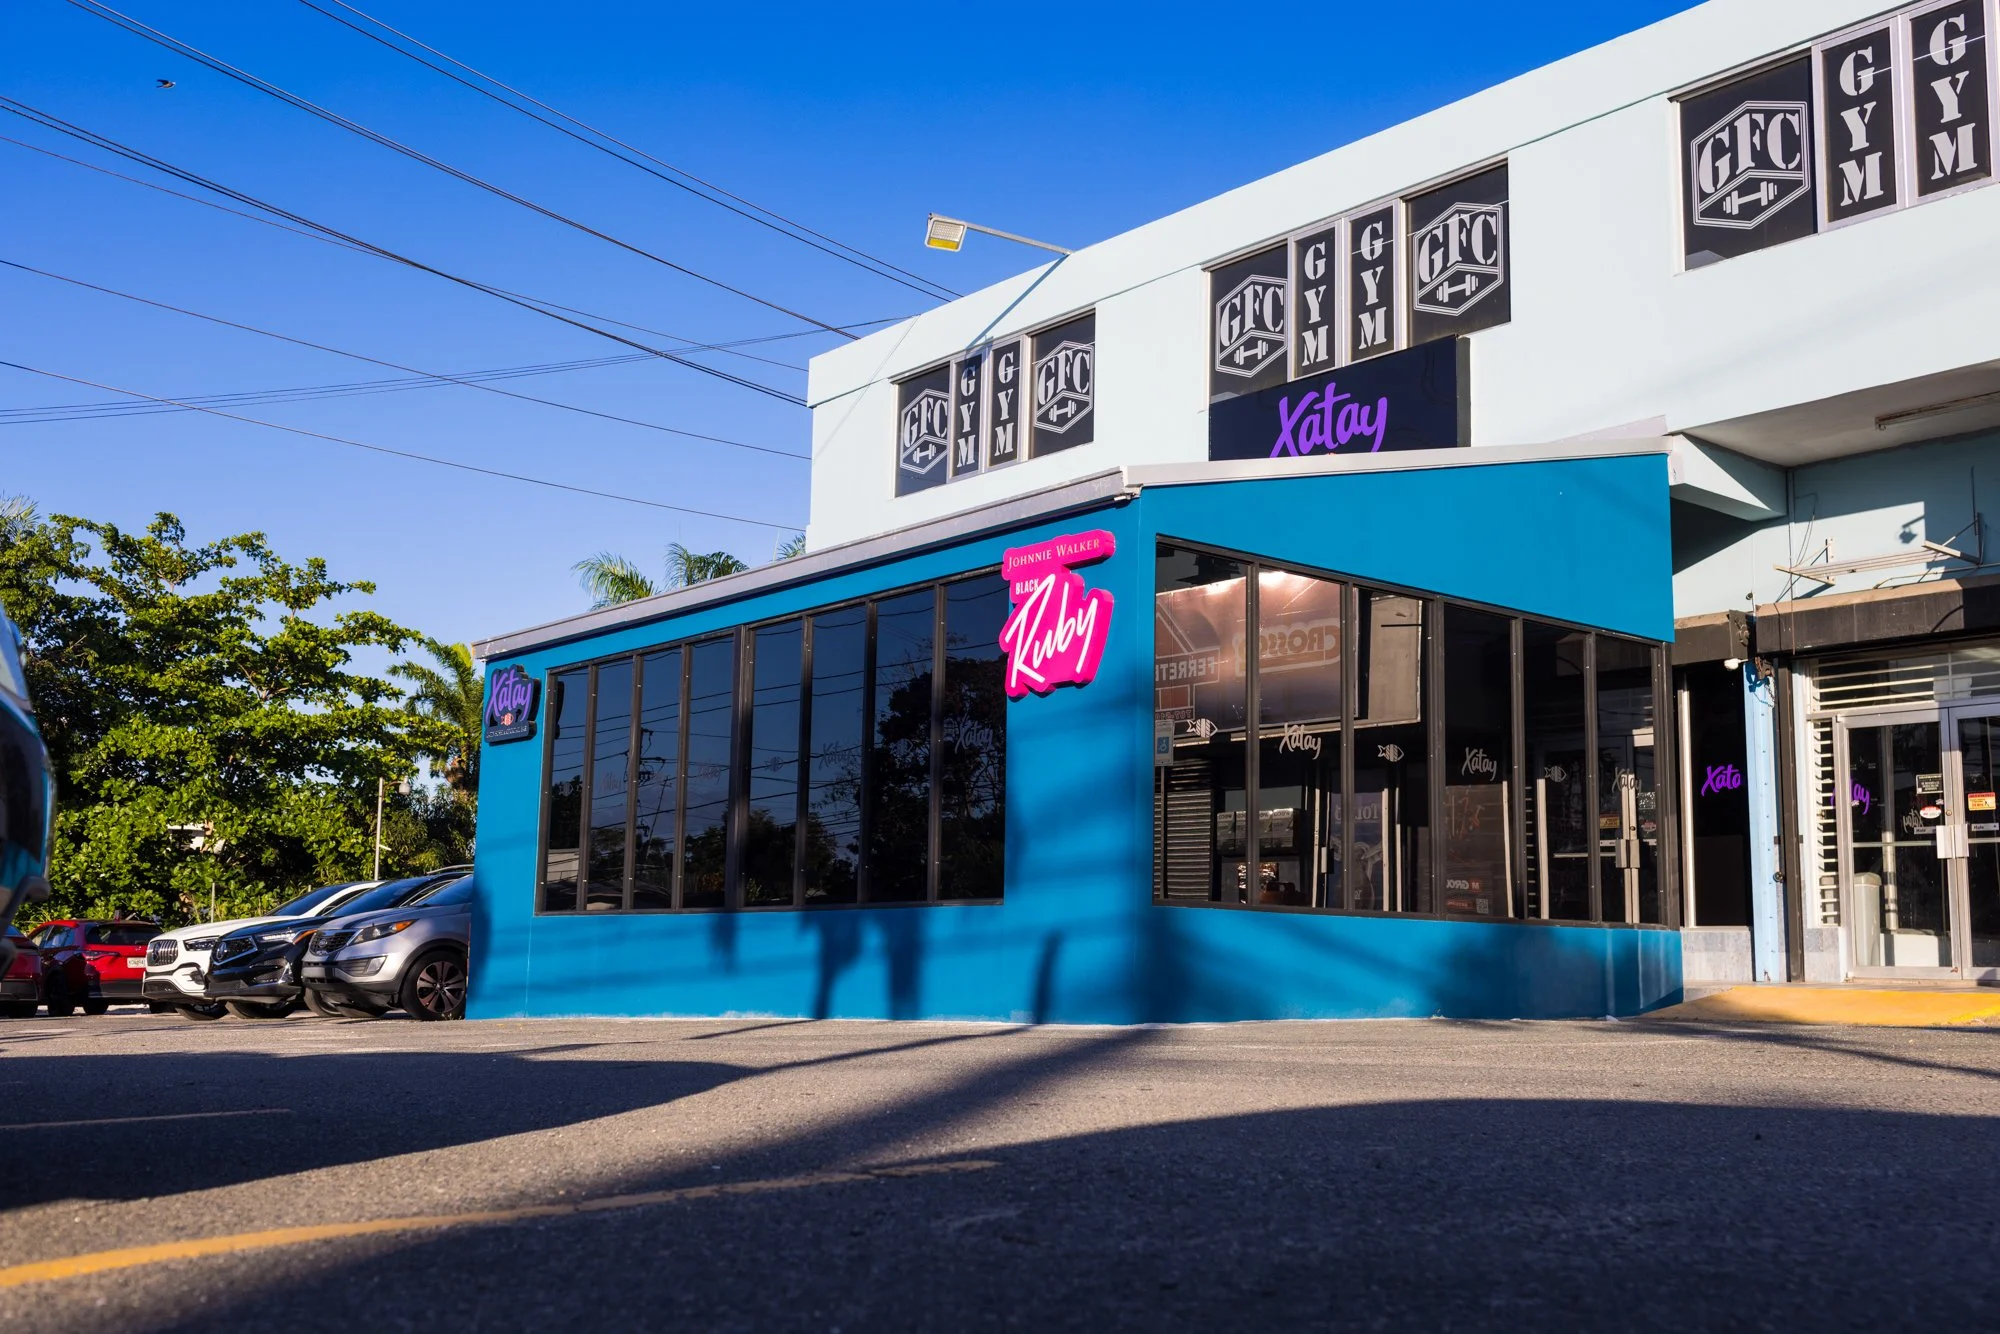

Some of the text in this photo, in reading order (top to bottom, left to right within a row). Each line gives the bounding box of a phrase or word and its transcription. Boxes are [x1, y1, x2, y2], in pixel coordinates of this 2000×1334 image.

[1838, 46, 1884, 207] GYM
[1929, 14, 1977, 180] GYM
[1699, 112, 1800, 194] GFC
[1358, 220, 1387, 350] GYM
[1418, 212, 1497, 283] GFC
[1220, 285, 1284, 347] GFC
[1302, 241, 1328, 366] GYM
[994, 352, 1014, 456] GYM
[1038, 349, 1090, 405] GFC
[904, 396, 947, 448] GFC
[957, 365, 976, 468] GYM
[1269, 382, 1388, 458] Xatay
[1015, 578, 1040, 595] BLACK
[1004, 574, 1098, 688] Ruby
[486, 669, 532, 724] Xatay
[1279, 724, 1321, 760] Xatay
[1461, 747, 1497, 781] Xatay
